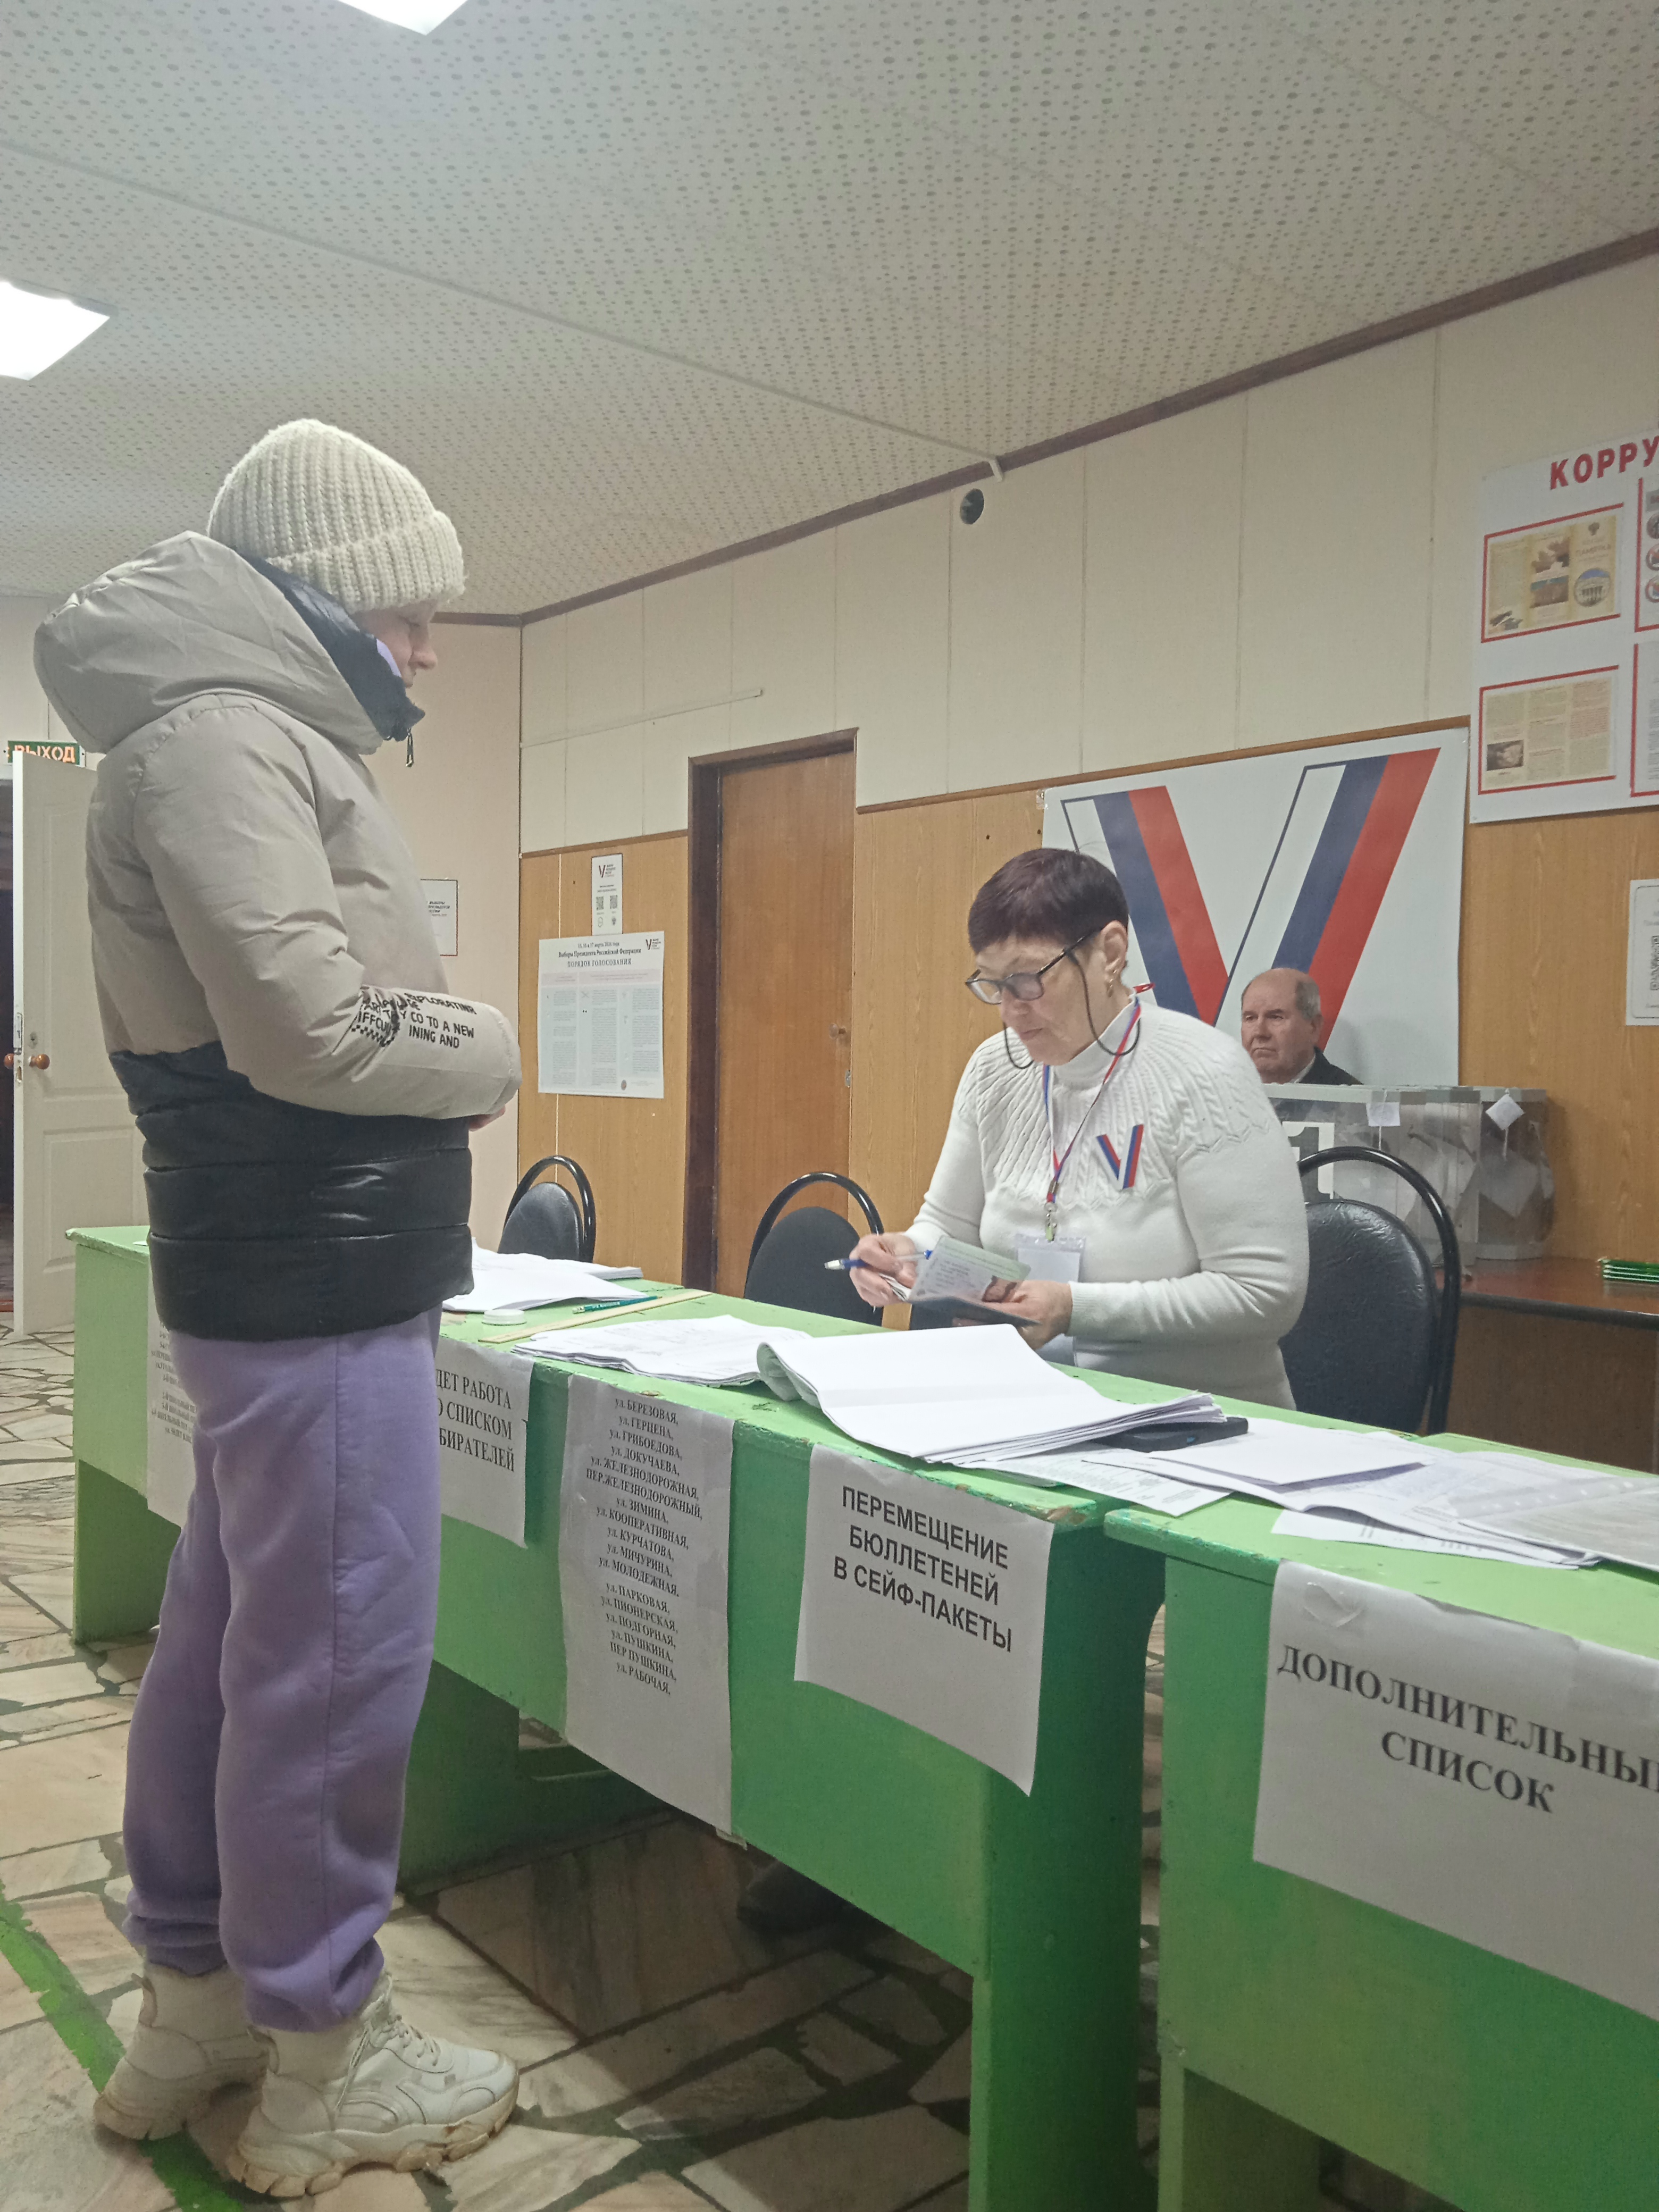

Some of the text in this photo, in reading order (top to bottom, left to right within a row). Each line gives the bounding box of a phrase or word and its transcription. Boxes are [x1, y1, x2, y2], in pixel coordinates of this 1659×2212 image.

[1550, 435, 1659, 490] КОРРУ
[592, 958, 631, 967] ГОЛОСОВАНИЯ
[426, 1016, 439, 1029] TO
[443, 1021, 450, 1032] A
[453, 1023, 474, 1038] NEW
[439, 1034, 459, 1049] AND
[447, 1401, 512, 1440] СПИСКОМ
[463, 1376, 512, 1410] РАБОТА
[843, 1485, 1008, 1570] ПЕРЕМЕЩЕНИЕ
[850, 1524, 998, 1605] БЮЛЛЕТЕНЕЙ
[834, 1556, 1011, 1652] В СЕЙФ-ПАКЕТЫ
[1277, 1644, 1659, 1792] ДОПОЛНИТЕЛЬНЫ
[1381, 1731, 1555, 1814] СПИСОК
